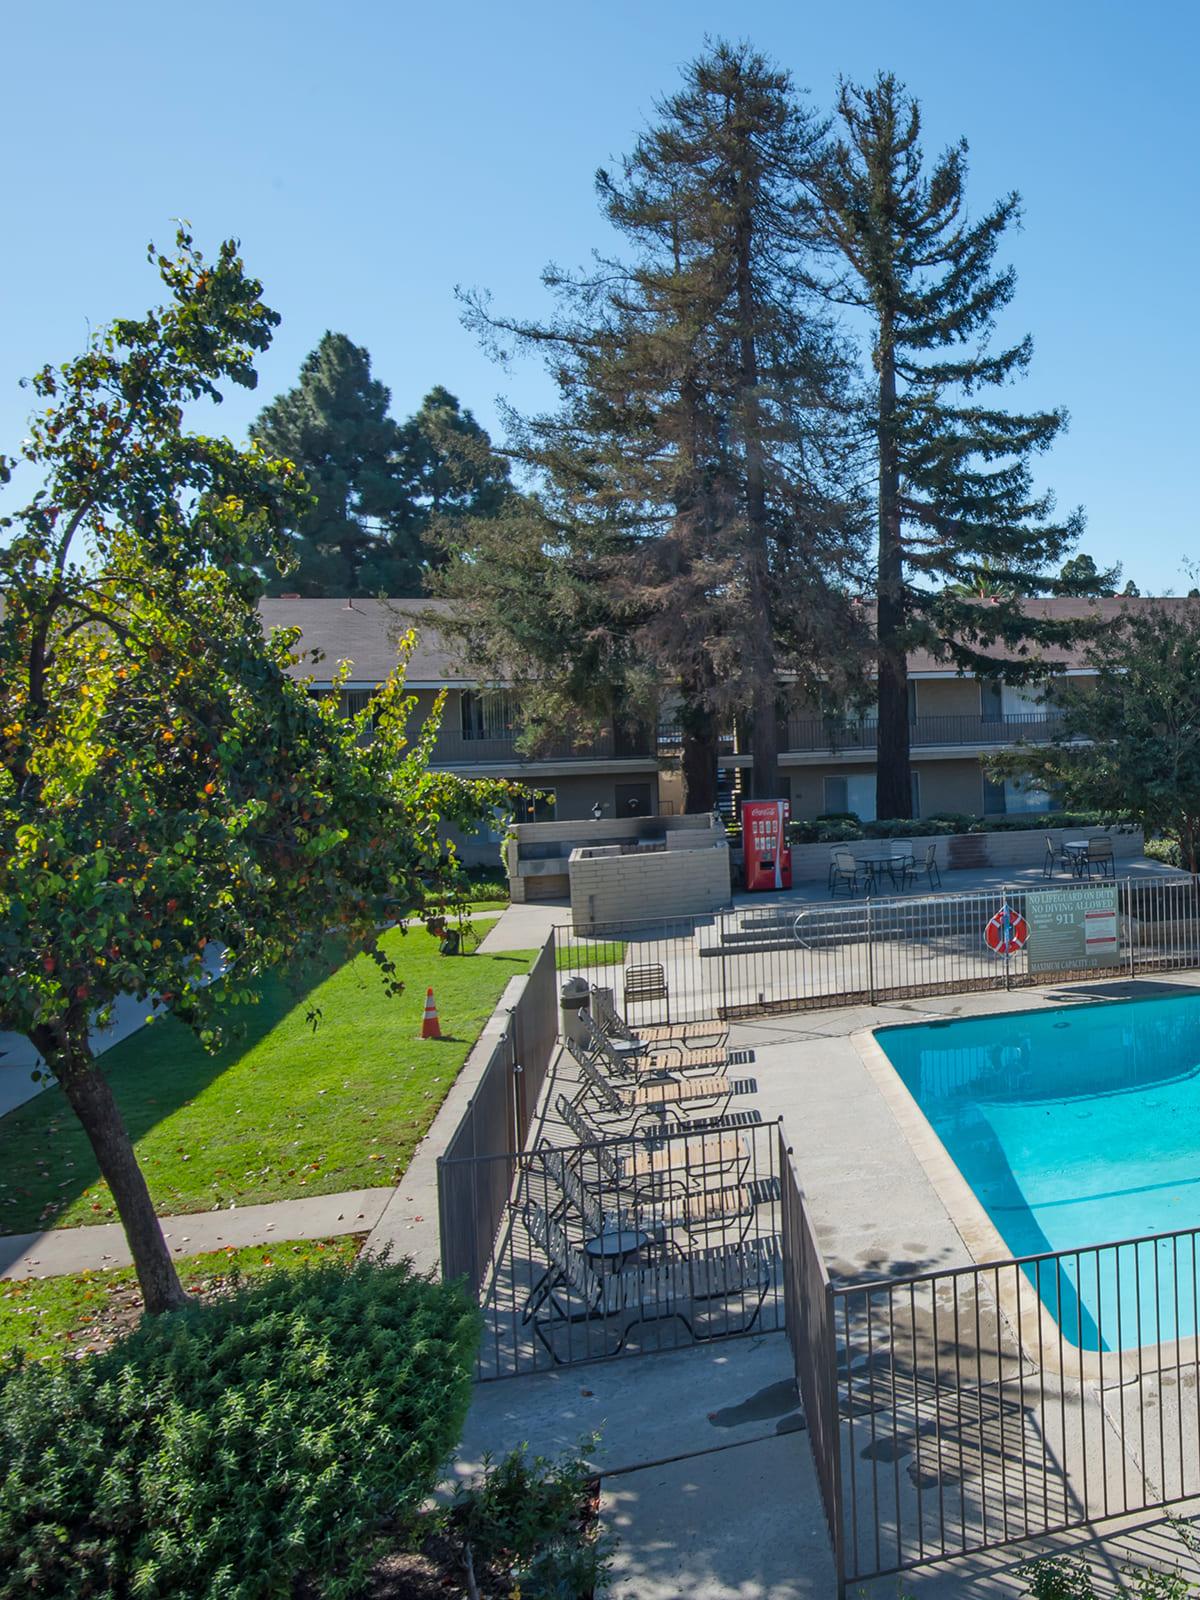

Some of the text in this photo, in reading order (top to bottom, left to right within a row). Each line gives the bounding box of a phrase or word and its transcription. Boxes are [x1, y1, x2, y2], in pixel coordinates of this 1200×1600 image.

[1029, 890, 1114, 905] NO LIFEGUARD ON DUTY
[1032, 900, 1113, 914] NO DIVING ALLOWED
[1056, 913, 1074, 925] 911
[1031, 961, 1060, 971] MAXIMUM
[1061, 960, 1088, 969] CAPACITY
